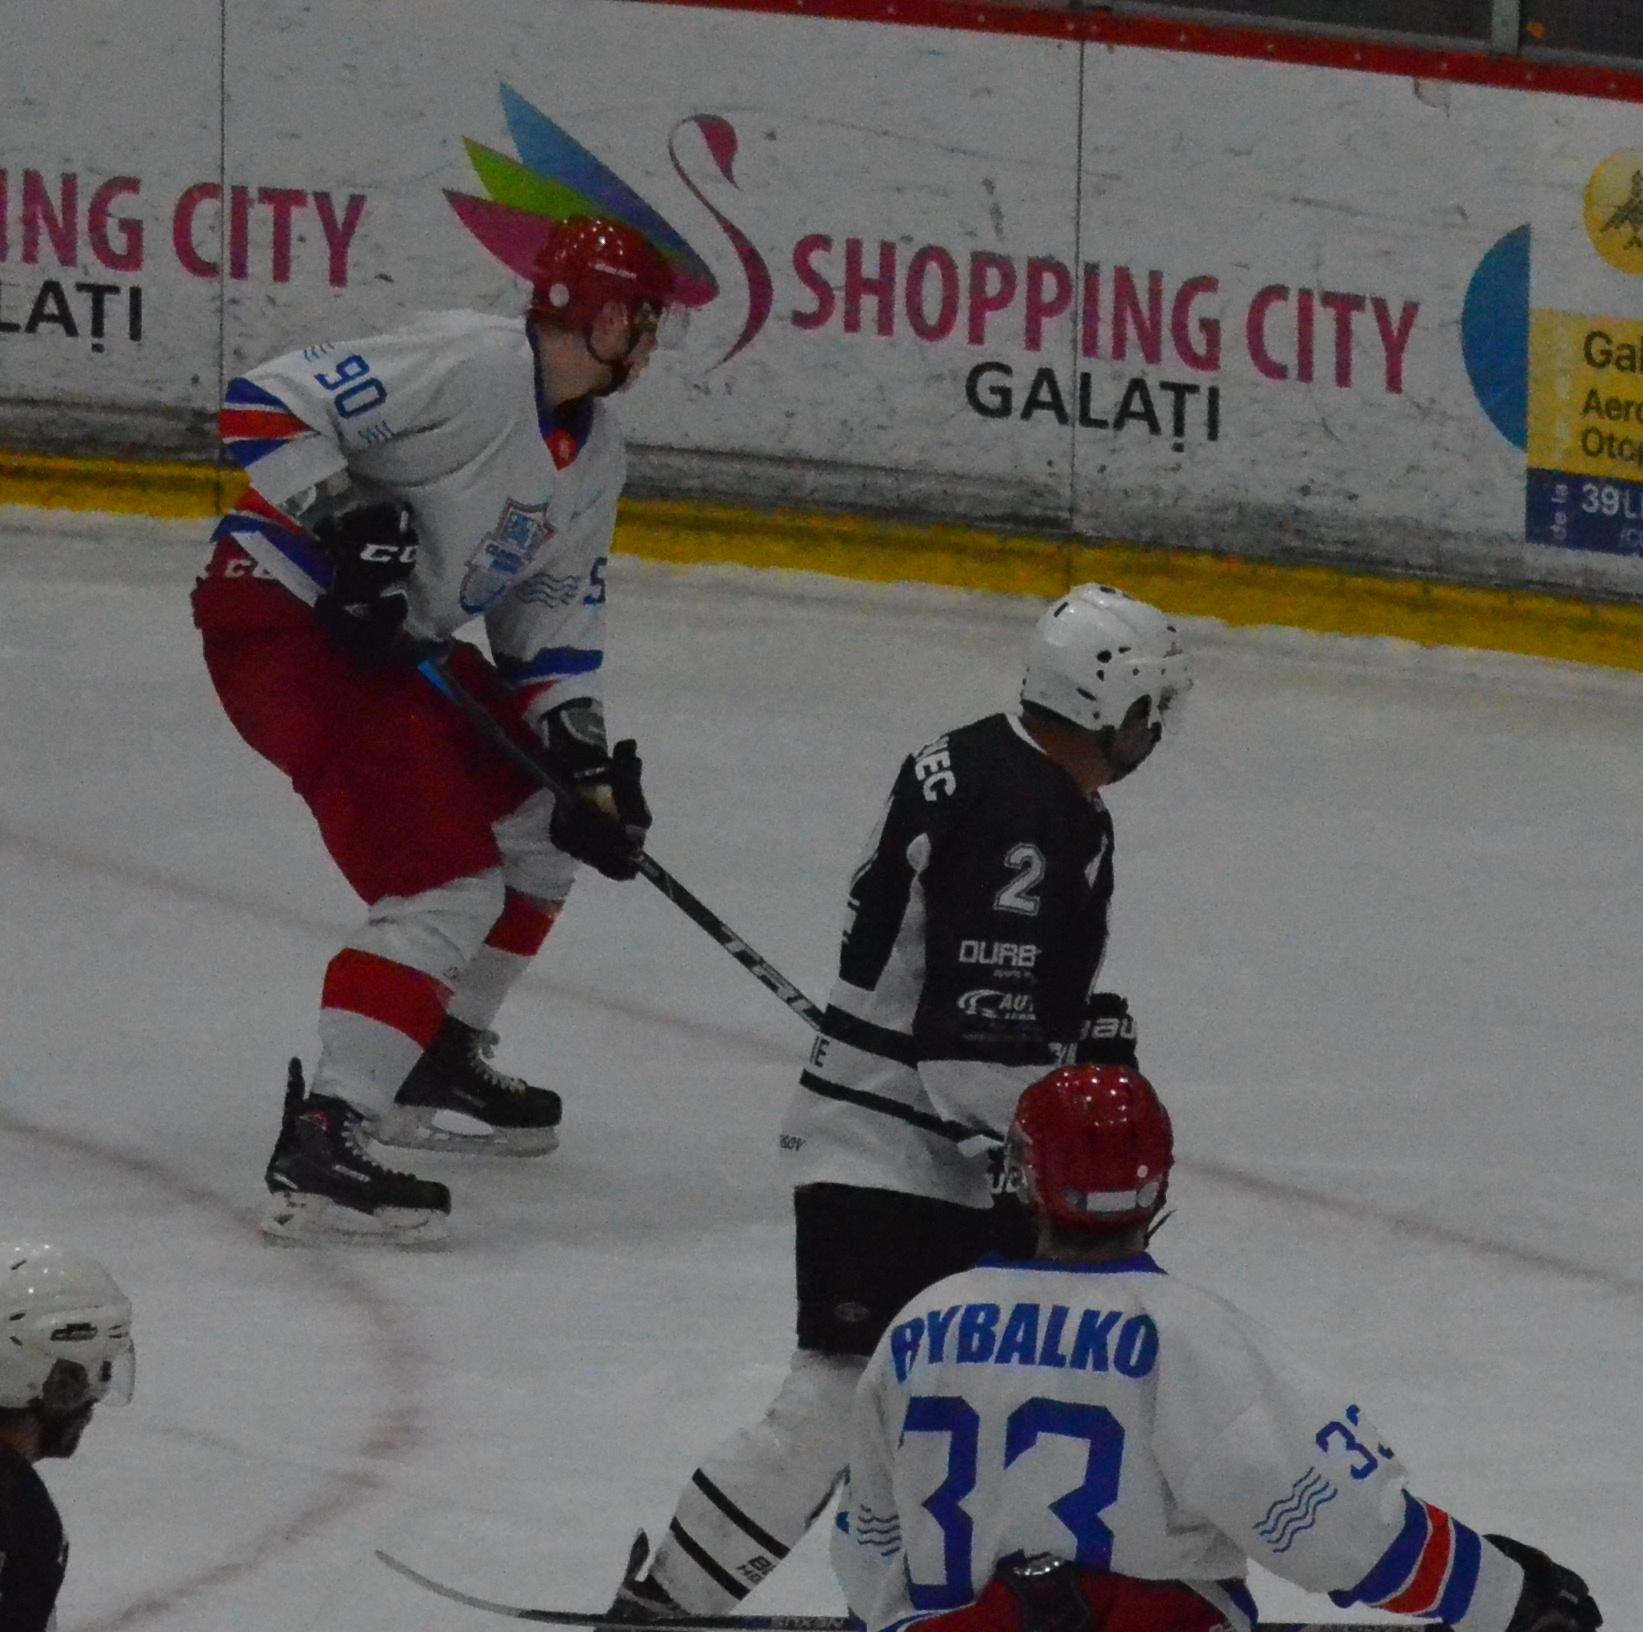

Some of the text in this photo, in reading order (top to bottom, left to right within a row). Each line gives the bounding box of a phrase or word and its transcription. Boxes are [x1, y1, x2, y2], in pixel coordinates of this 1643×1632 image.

[173, 181, 367, 288] CITY
[791, 233, 1420, 394] SHOPPING CITY
[313, 353, 387, 419] 90
[965, 361, 1220, 452] GALAȚI
[1581, 482, 1619, 516] 39
[992, 841, 1047, 917] 2
[890, 1303, 1159, 1384] RYBALKO
[897, 1395, 1126, 1610] 33
